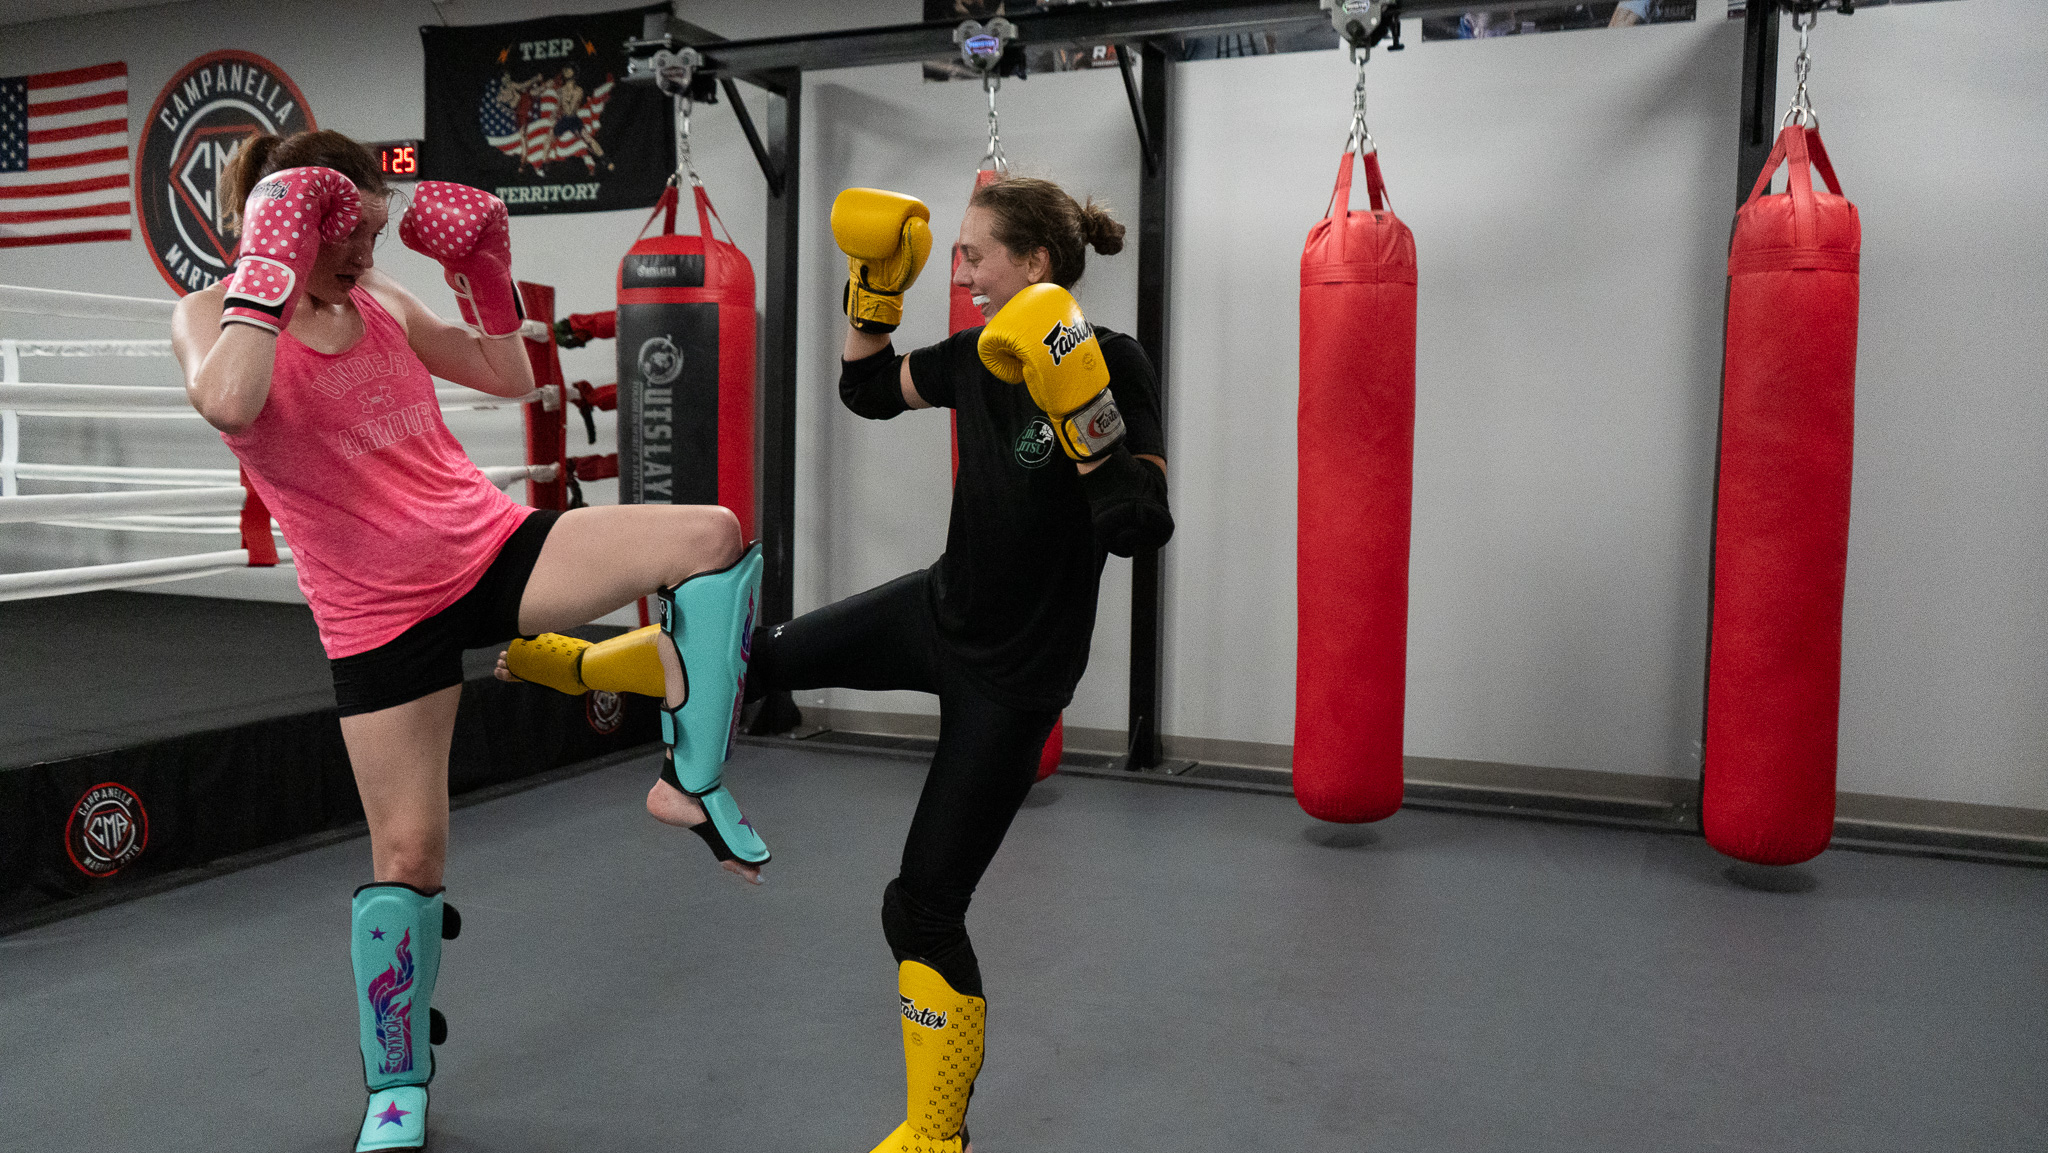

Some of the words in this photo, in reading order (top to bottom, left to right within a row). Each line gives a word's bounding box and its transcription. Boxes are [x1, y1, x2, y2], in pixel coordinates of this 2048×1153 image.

[519, 38, 574, 61] TEEP
[160, 65, 294, 131] CAMPANELLA
[181, 139, 241, 238] CM
[495, 183, 600, 204] TERRITORY
[311, 351, 409, 400] UNDER
[338, 401, 435, 459] ARMOUR
[1016, 441, 1046, 455] JITSU
[78, 787, 133, 816] CAMPANELLA
[88, 812, 129, 850] CMA
[384, 1018, 404, 1060] YOKKAO
